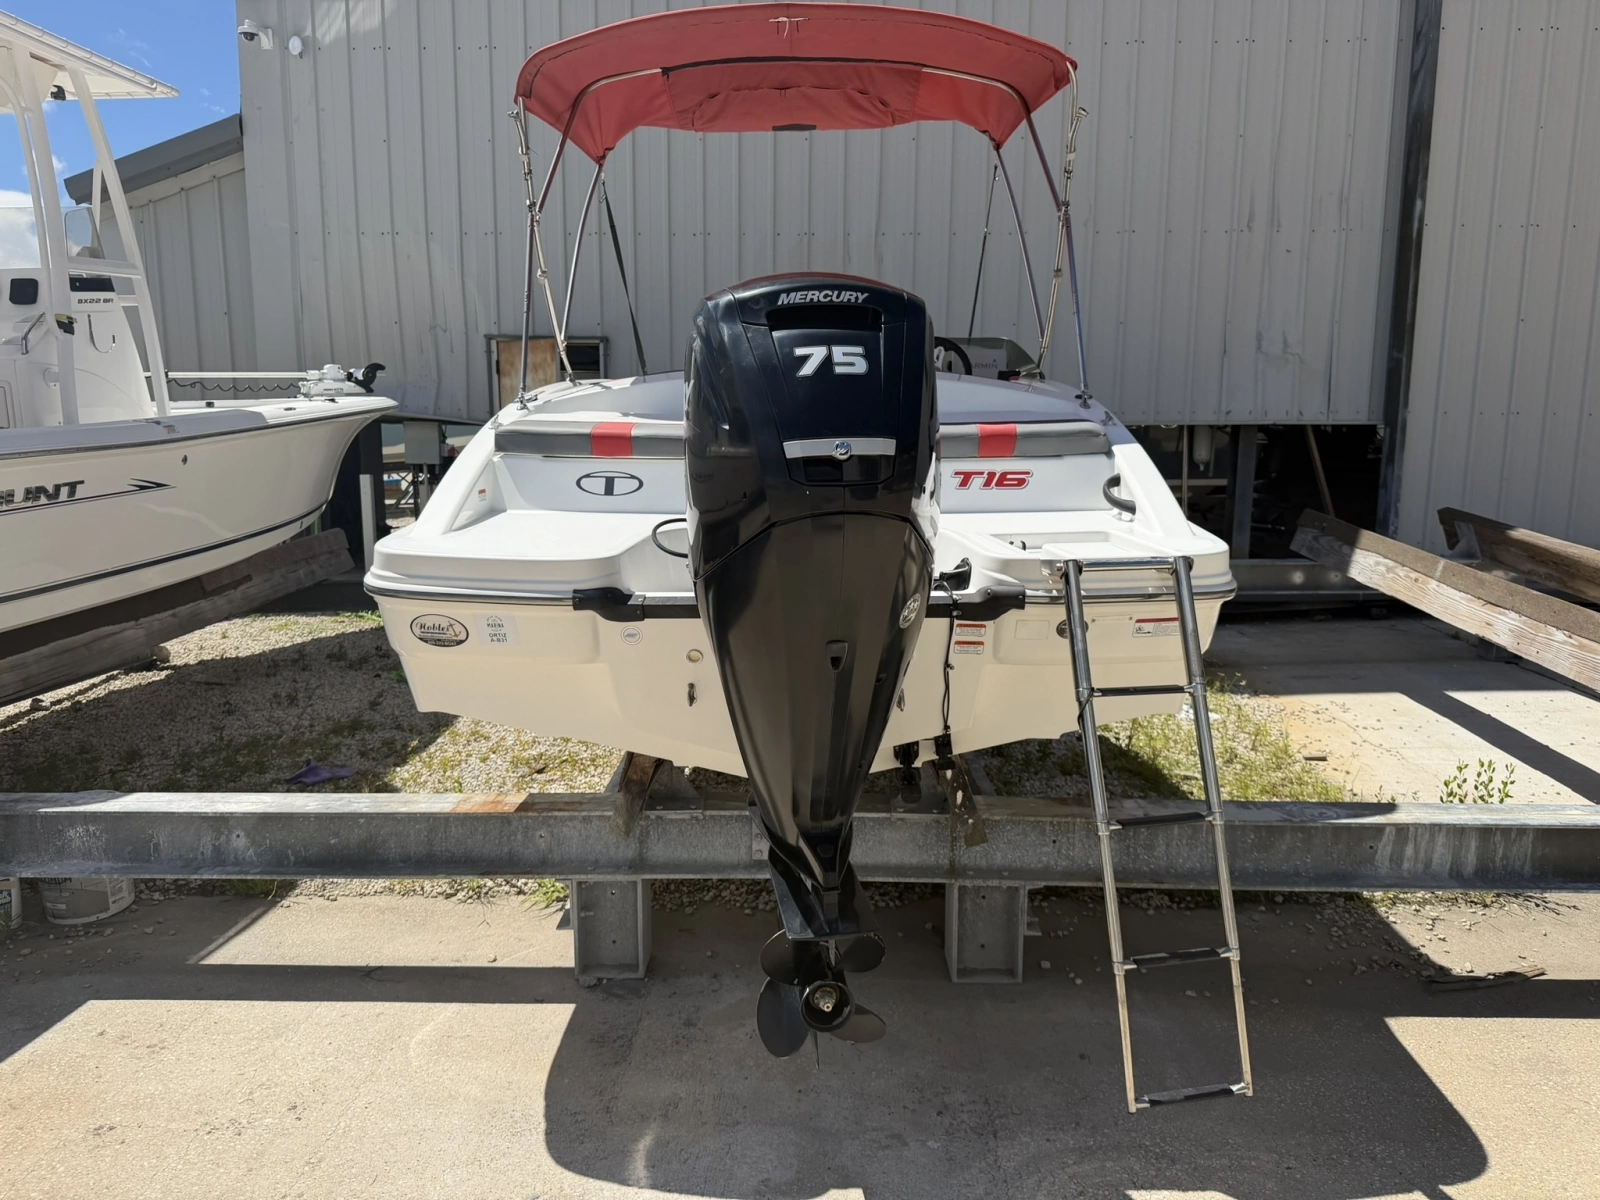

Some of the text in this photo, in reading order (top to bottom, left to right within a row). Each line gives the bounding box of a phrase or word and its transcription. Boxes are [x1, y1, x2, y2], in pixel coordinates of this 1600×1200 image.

[777, 290, 869, 305] MERCURY
[793, 345, 869, 377] 75
[950, 469, 1034, 490] T16
[0, 479, 85, 508] UNT
